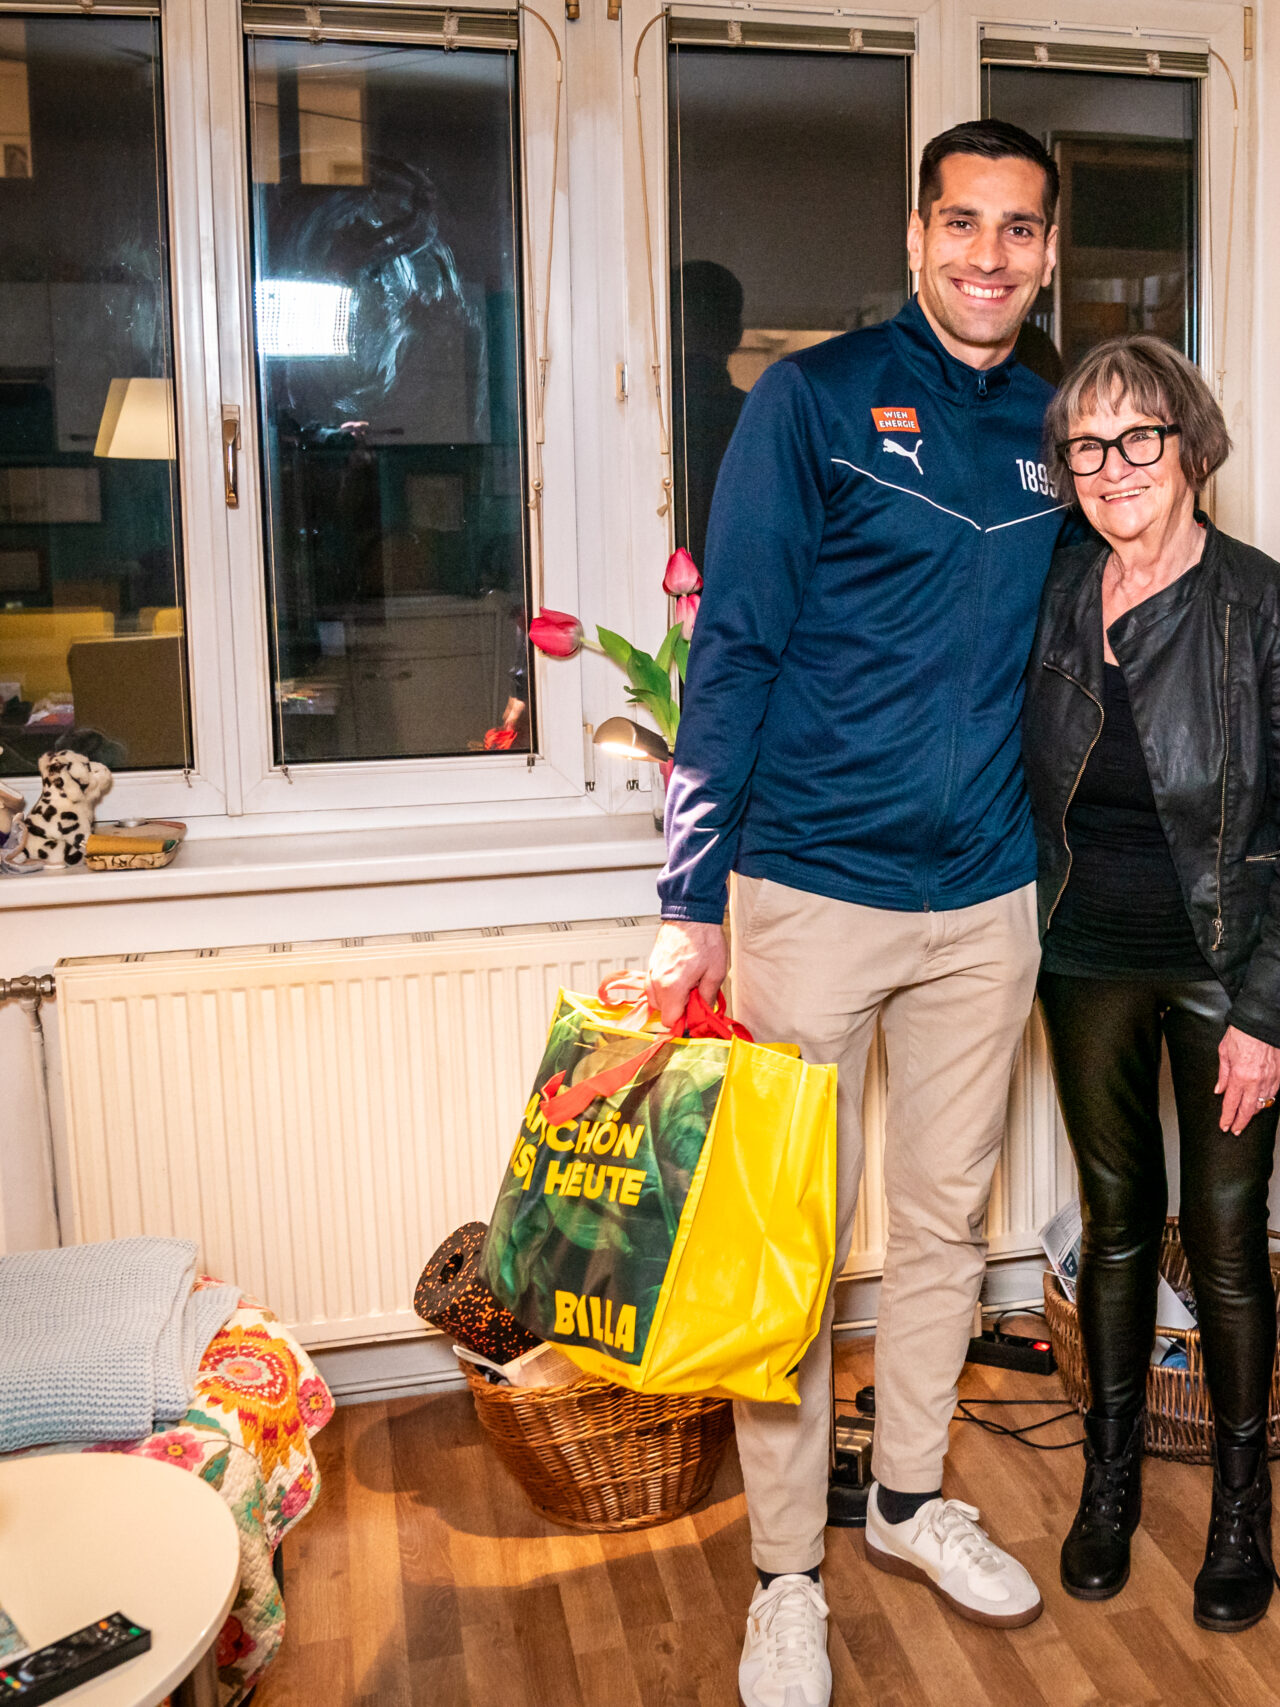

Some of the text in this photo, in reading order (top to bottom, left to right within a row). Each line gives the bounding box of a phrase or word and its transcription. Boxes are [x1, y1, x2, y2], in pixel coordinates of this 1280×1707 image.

[879, 420, 916, 429] ENERGIE
[883, 411, 908, 419] WIEN
[544, 1160, 647, 1207] HEUTE
[553, 1289, 637, 1354] BILLA
